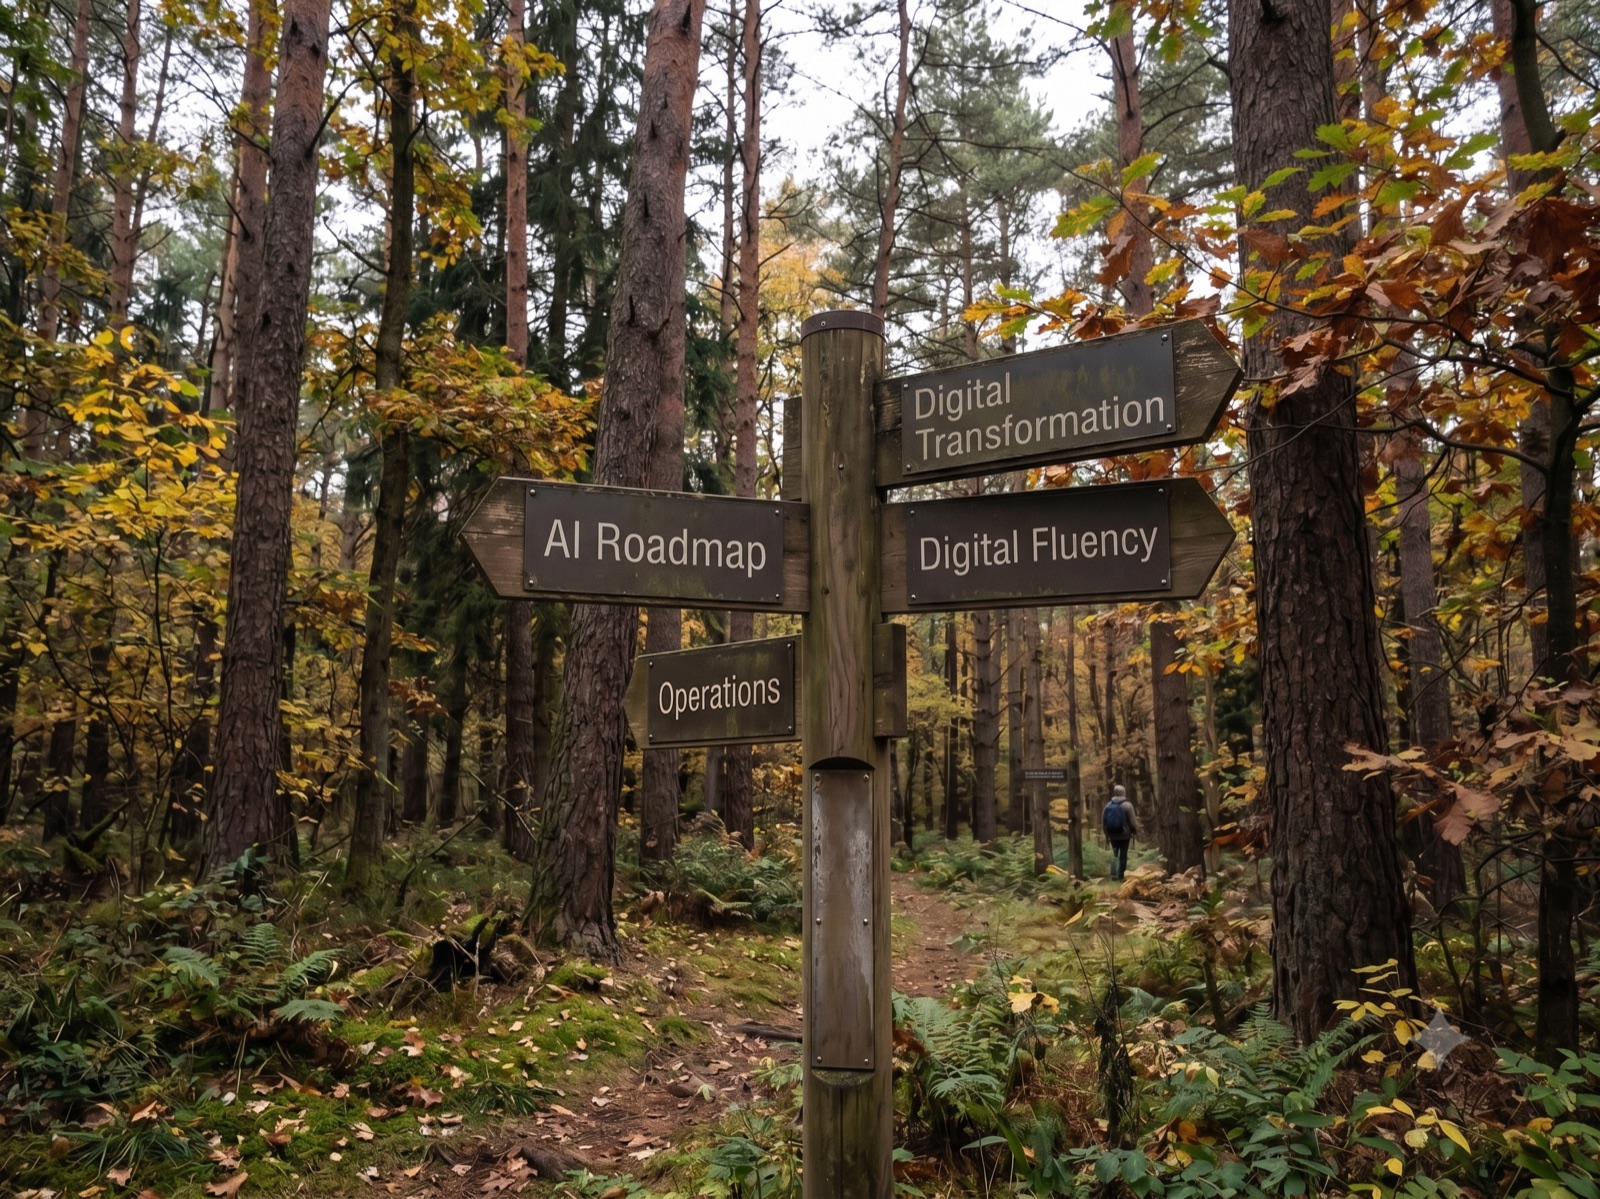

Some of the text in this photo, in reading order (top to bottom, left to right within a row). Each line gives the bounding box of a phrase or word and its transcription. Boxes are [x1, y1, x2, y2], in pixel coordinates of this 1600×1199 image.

[915, 372, 1011, 421] Digital
[915, 395, 1164, 460] Transformation
[544, 519, 766, 578] AI Roadmap
[920, 526, 1158, 577] Digital Fluency
[659, 674, 781, 720] Operations
